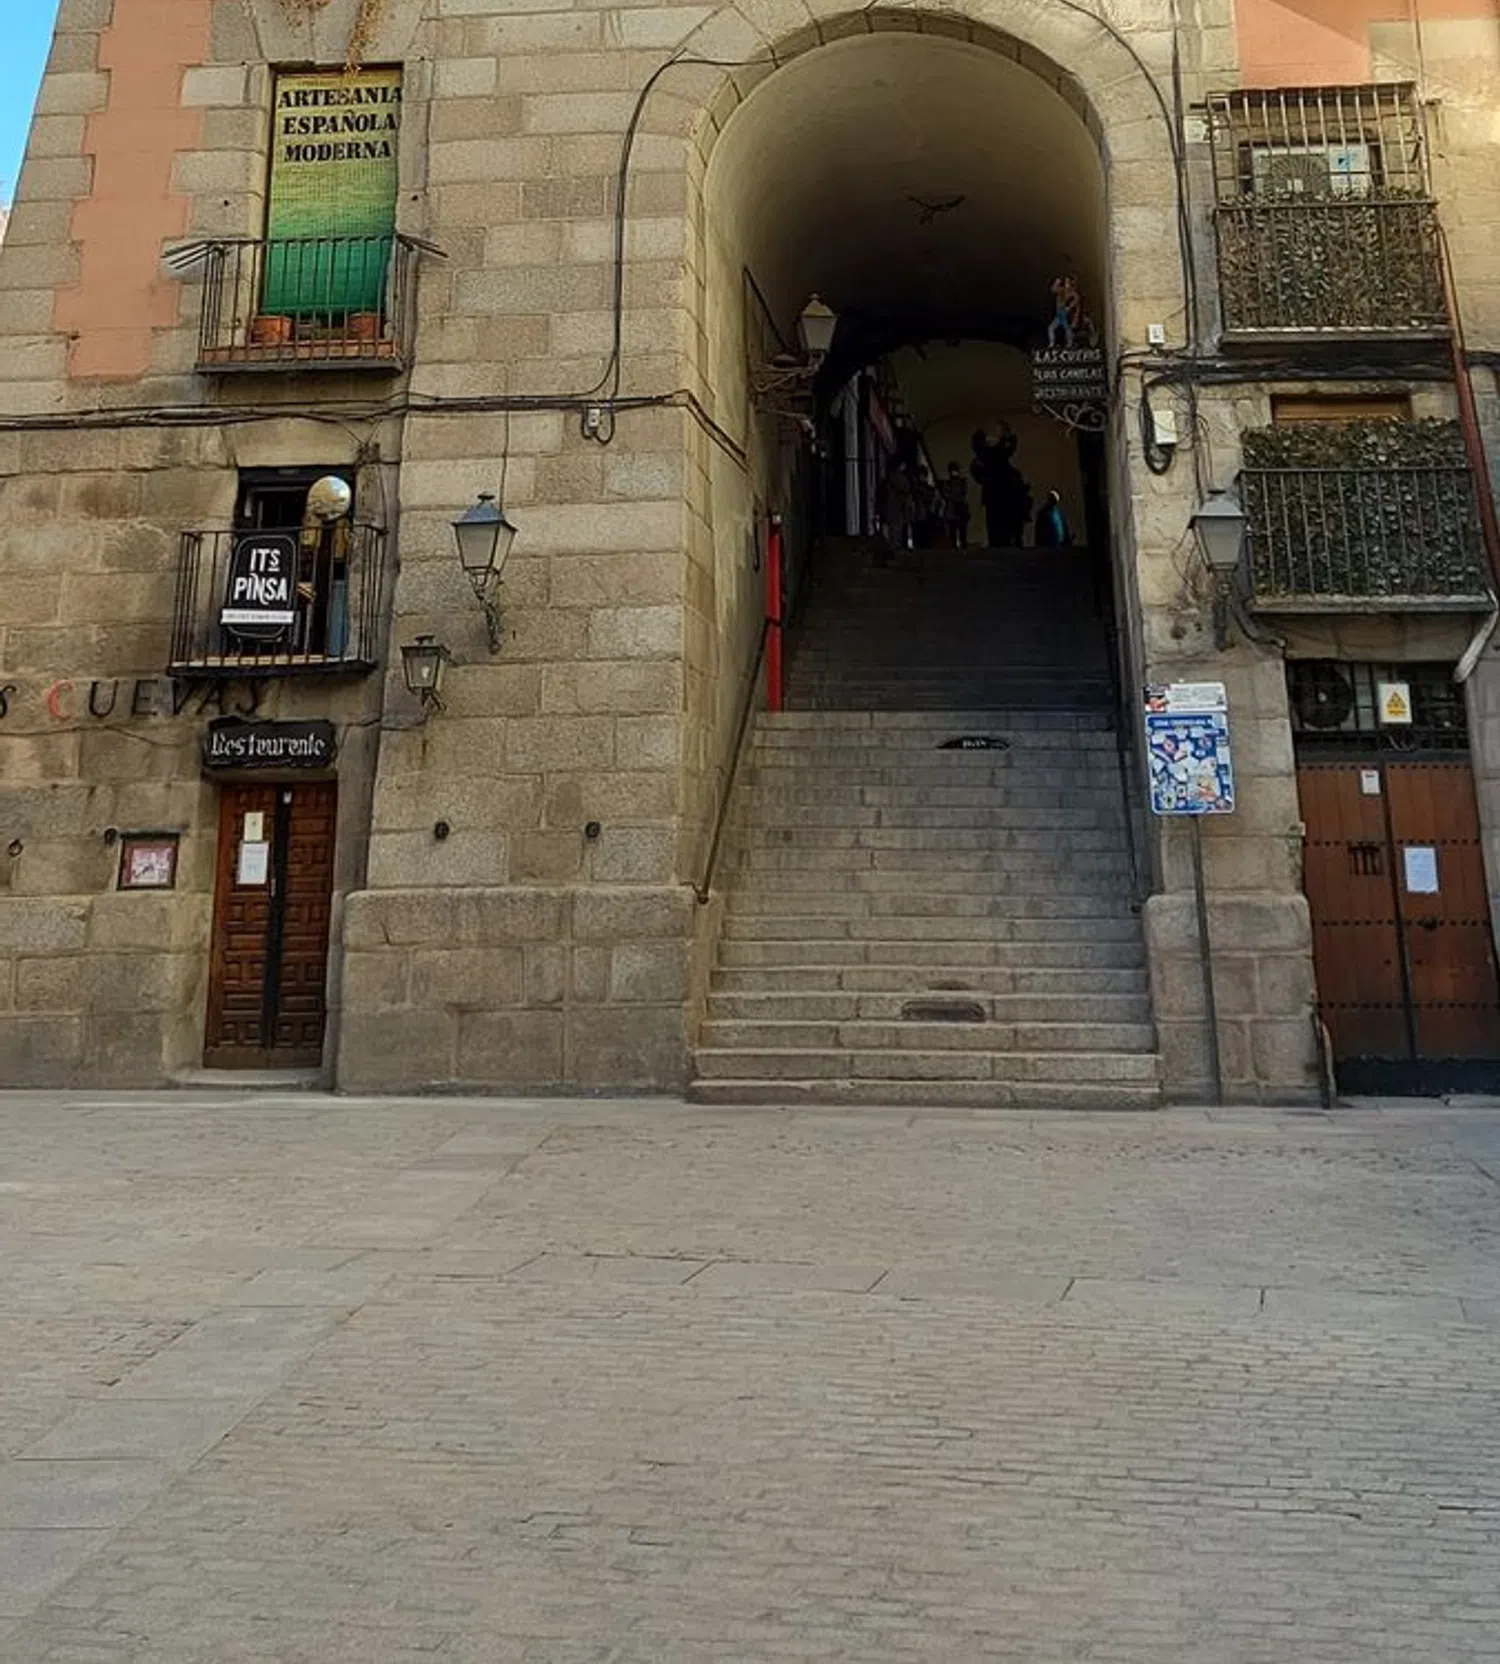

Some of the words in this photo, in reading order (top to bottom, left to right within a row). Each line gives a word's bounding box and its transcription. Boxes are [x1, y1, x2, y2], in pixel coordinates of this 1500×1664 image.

[277, 86, 402, 109] ARTESANIA
[283, 109, 399, 135] ESPAÑOLA
[283, 140, 392, 163] MODERNA
[233, 572, 288, 605] PINSA
[46, 677, 267, 722] CUEVAS
